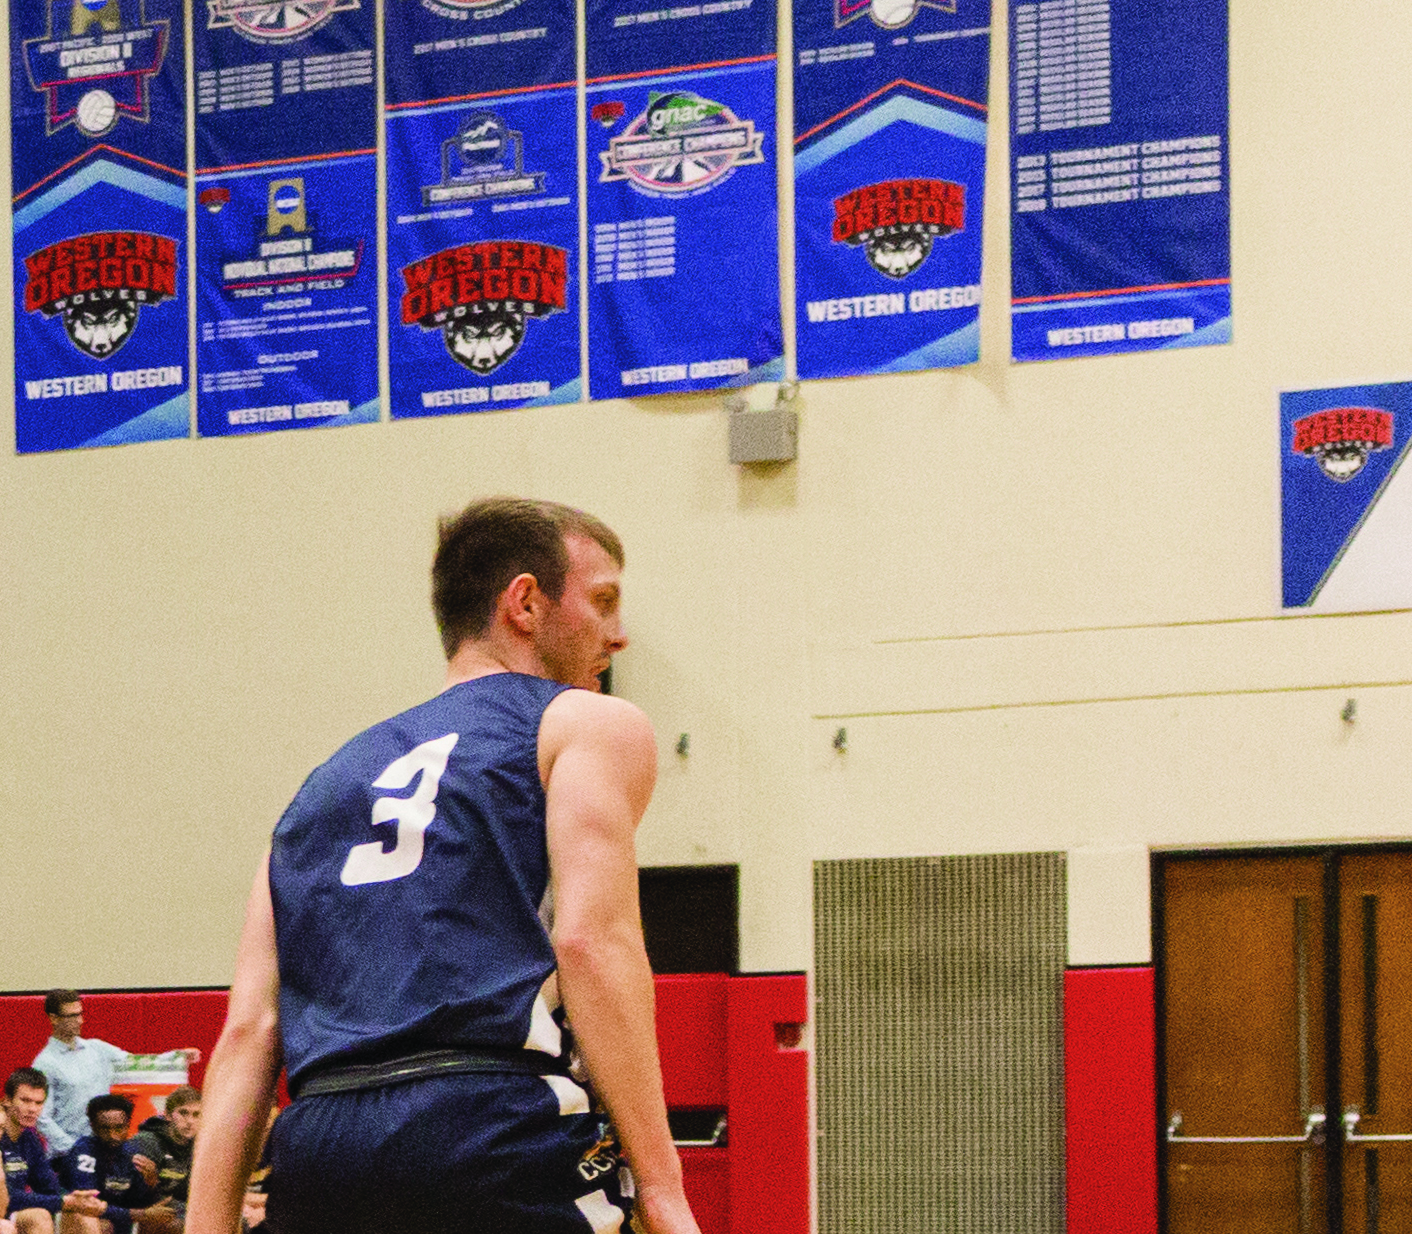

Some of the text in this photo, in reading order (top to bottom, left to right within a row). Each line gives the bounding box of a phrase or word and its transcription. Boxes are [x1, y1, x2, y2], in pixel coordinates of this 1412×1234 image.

[834, 179, 965, 213] WESTERN
[833, 201, 965, 242] OREGON
[24, 232, 178, 276] WESTERN
[402, 241, 568, 291] WESTERN
[24, 256, 176, 312] OREGON
[55, 289, 147, 310] WOLVES
[401, 267, 567, 325] OREGON
[434, 302, 535, 322] WOLVES
[807, 293, 906, 322] WESTERN
[1047, 318, 1194, 347] WESTERN OREGON
[25, 373, 108, 400] WESTERN
[111, 366, 183, 393] OREGON
[621, 358, 749, 386] WESTERN OREGON
[421, 381, 551, 408] WESTERN OREGON
[227, 400, 350, 425] WESTERN OREGON
[339, 732, 460, 886] 3
